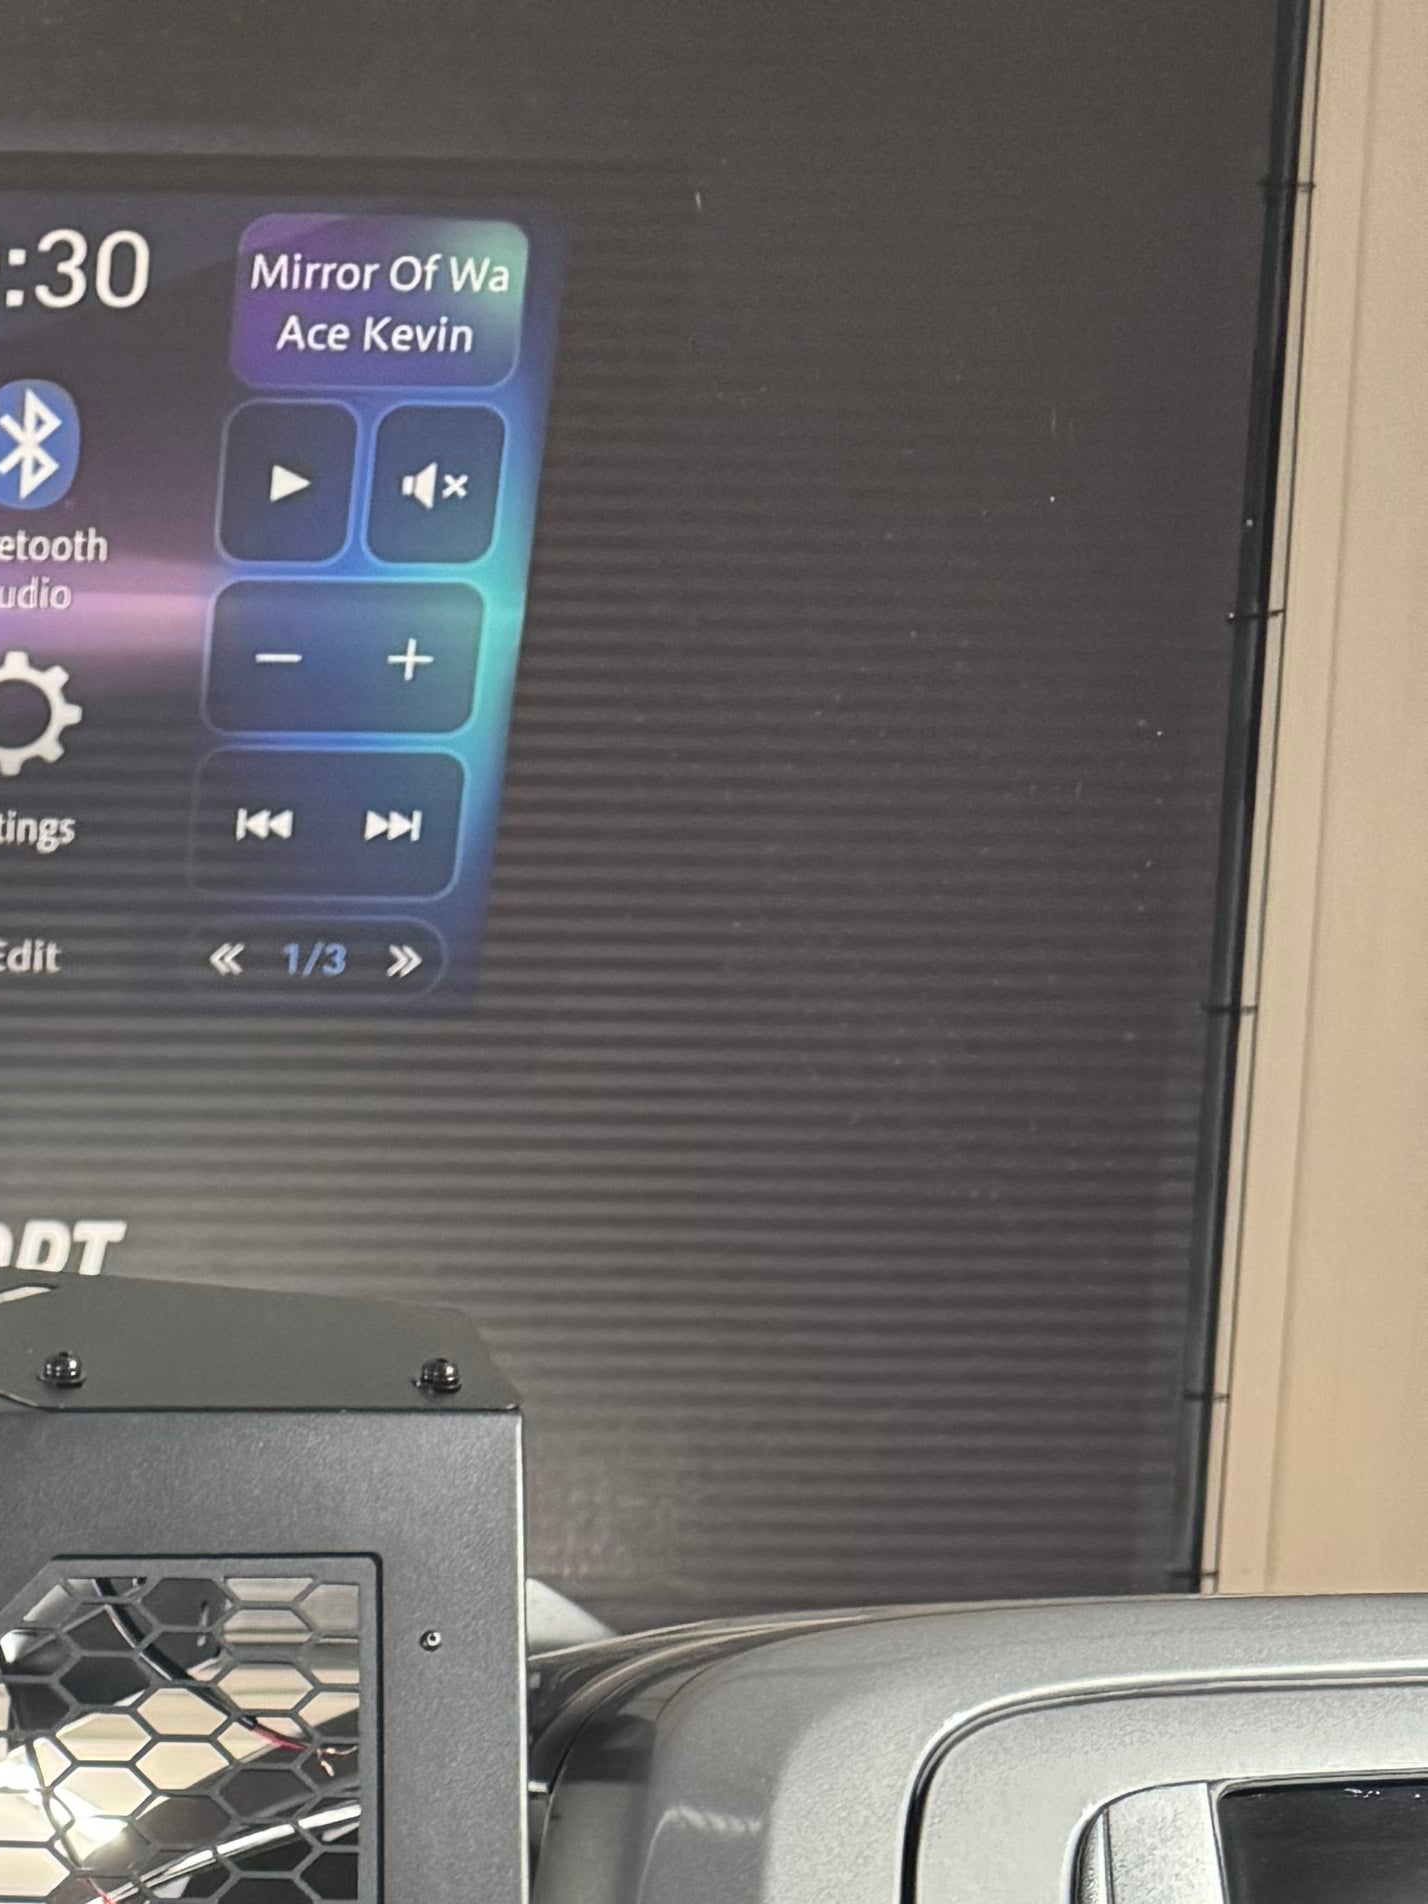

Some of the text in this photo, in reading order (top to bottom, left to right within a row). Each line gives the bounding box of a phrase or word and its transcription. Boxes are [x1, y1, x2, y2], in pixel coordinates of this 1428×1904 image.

[250, 254, 512, 294] Mirror Of Wa
[276, 314, 474, 354] Ace Kevin
[283, 944, 349, 976] 1/3
